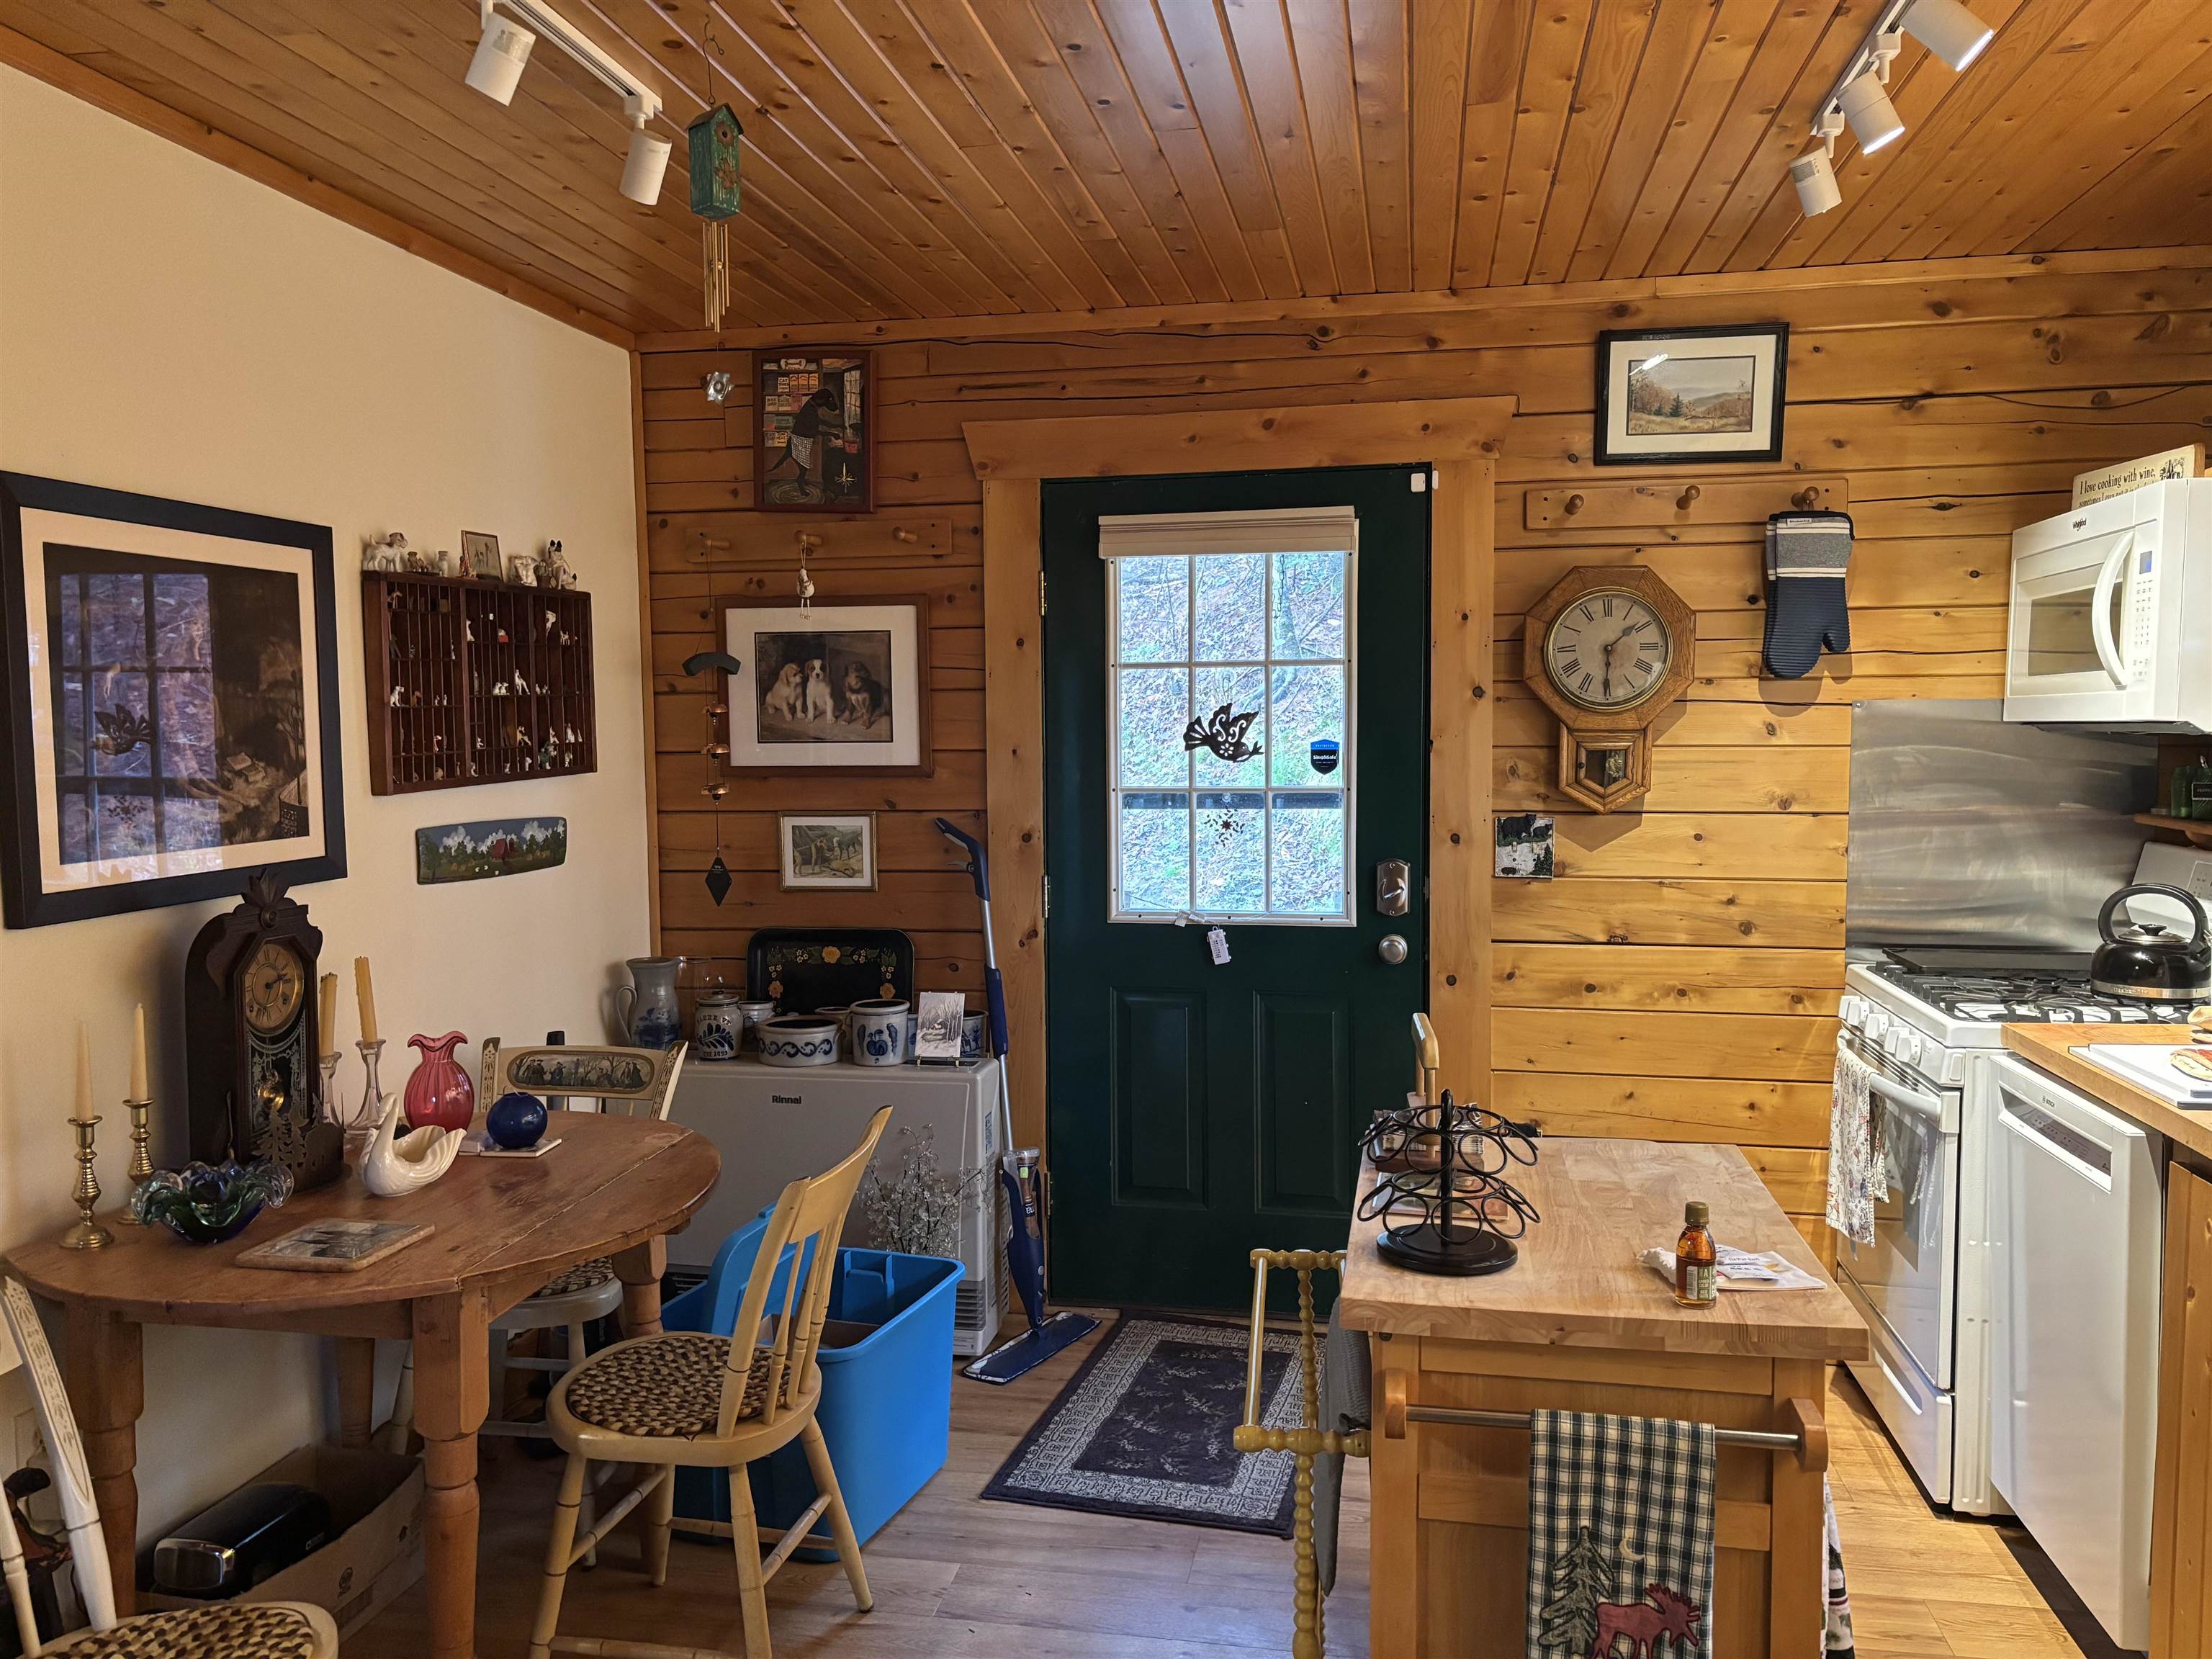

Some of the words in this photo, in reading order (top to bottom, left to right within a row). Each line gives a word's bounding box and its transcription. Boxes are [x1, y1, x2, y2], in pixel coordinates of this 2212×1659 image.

[2080, 481, 2083, 495] I
[2085, 482, 2097, 494] love
[2098, 474, 2122, 490] cooking
[2124, 468, 2137, 483] with
[2139, 467, 2156, 479] wine,
[2079, 495, 2101, 508] sometimes
